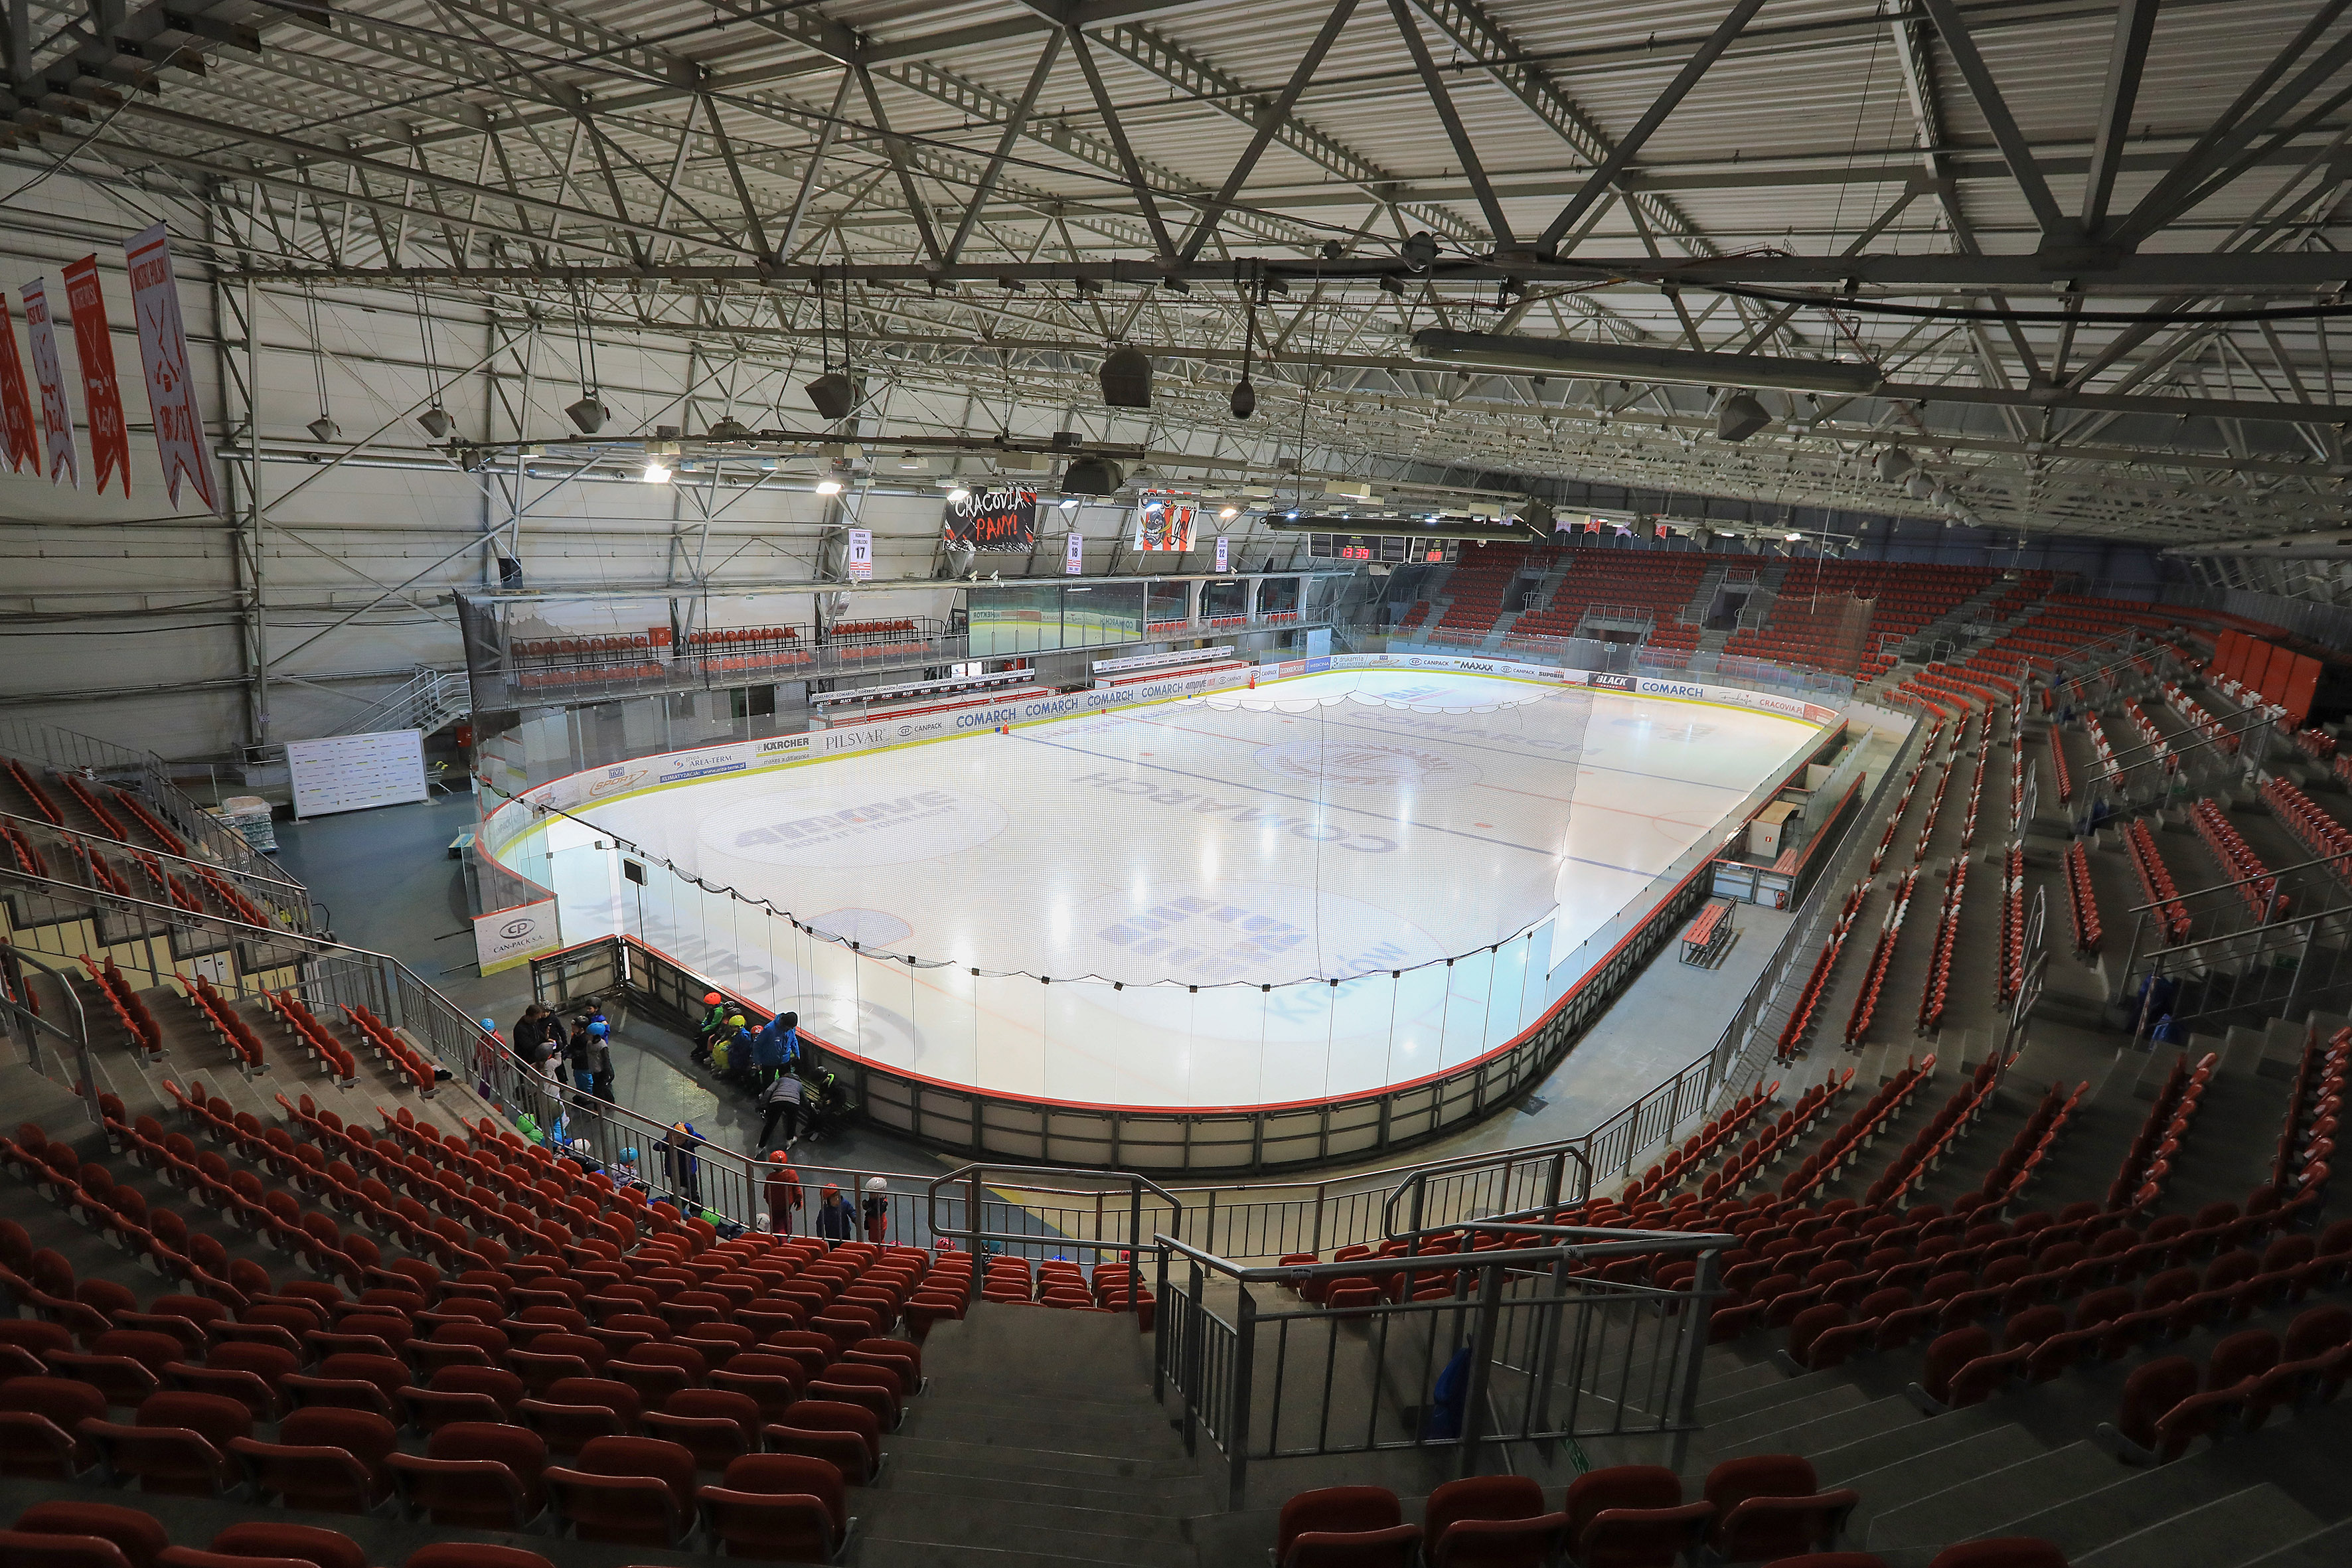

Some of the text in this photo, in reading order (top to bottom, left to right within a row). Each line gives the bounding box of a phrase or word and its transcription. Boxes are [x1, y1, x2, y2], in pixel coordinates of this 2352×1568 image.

[955, 487, 1024, 518] CRACOVIA
[977, 512, 1018, 541] PANY!
[856, 546, 865, 559] 17
[1071, 547, 1078, 557] 18
[1219, 549, 1225, 558] 22
[1460, 662, 1494, 671] MAXXX
[1596, 675, 1628, 686] BLACK
[1142, 682, 1183, 697] COMARCH
[1642, 682, 1703, 697] COMARCH
[1087, 690, 1133, 706] COMARCH
[1026, 698, 1078, 716] COMARCH
[1760, 699, 1802, 714] CRACOVIA.PL
[957, 708, 1016, 728] COMARCH
[915, 722, 942, 732] CANPACK
[763, 738, 809, 751] KÄRCHER
[826, 729, 883, 749] PILSVAR
[690, 755, 732, 767] AREA-TERM
[610, 769, 623, 777] TVP
[661, 771, 700, 781] KLIMATYZACJA:
[594, 774, 635, 790] SPORT
[493, 939, 530, 953] CAN-PACK
